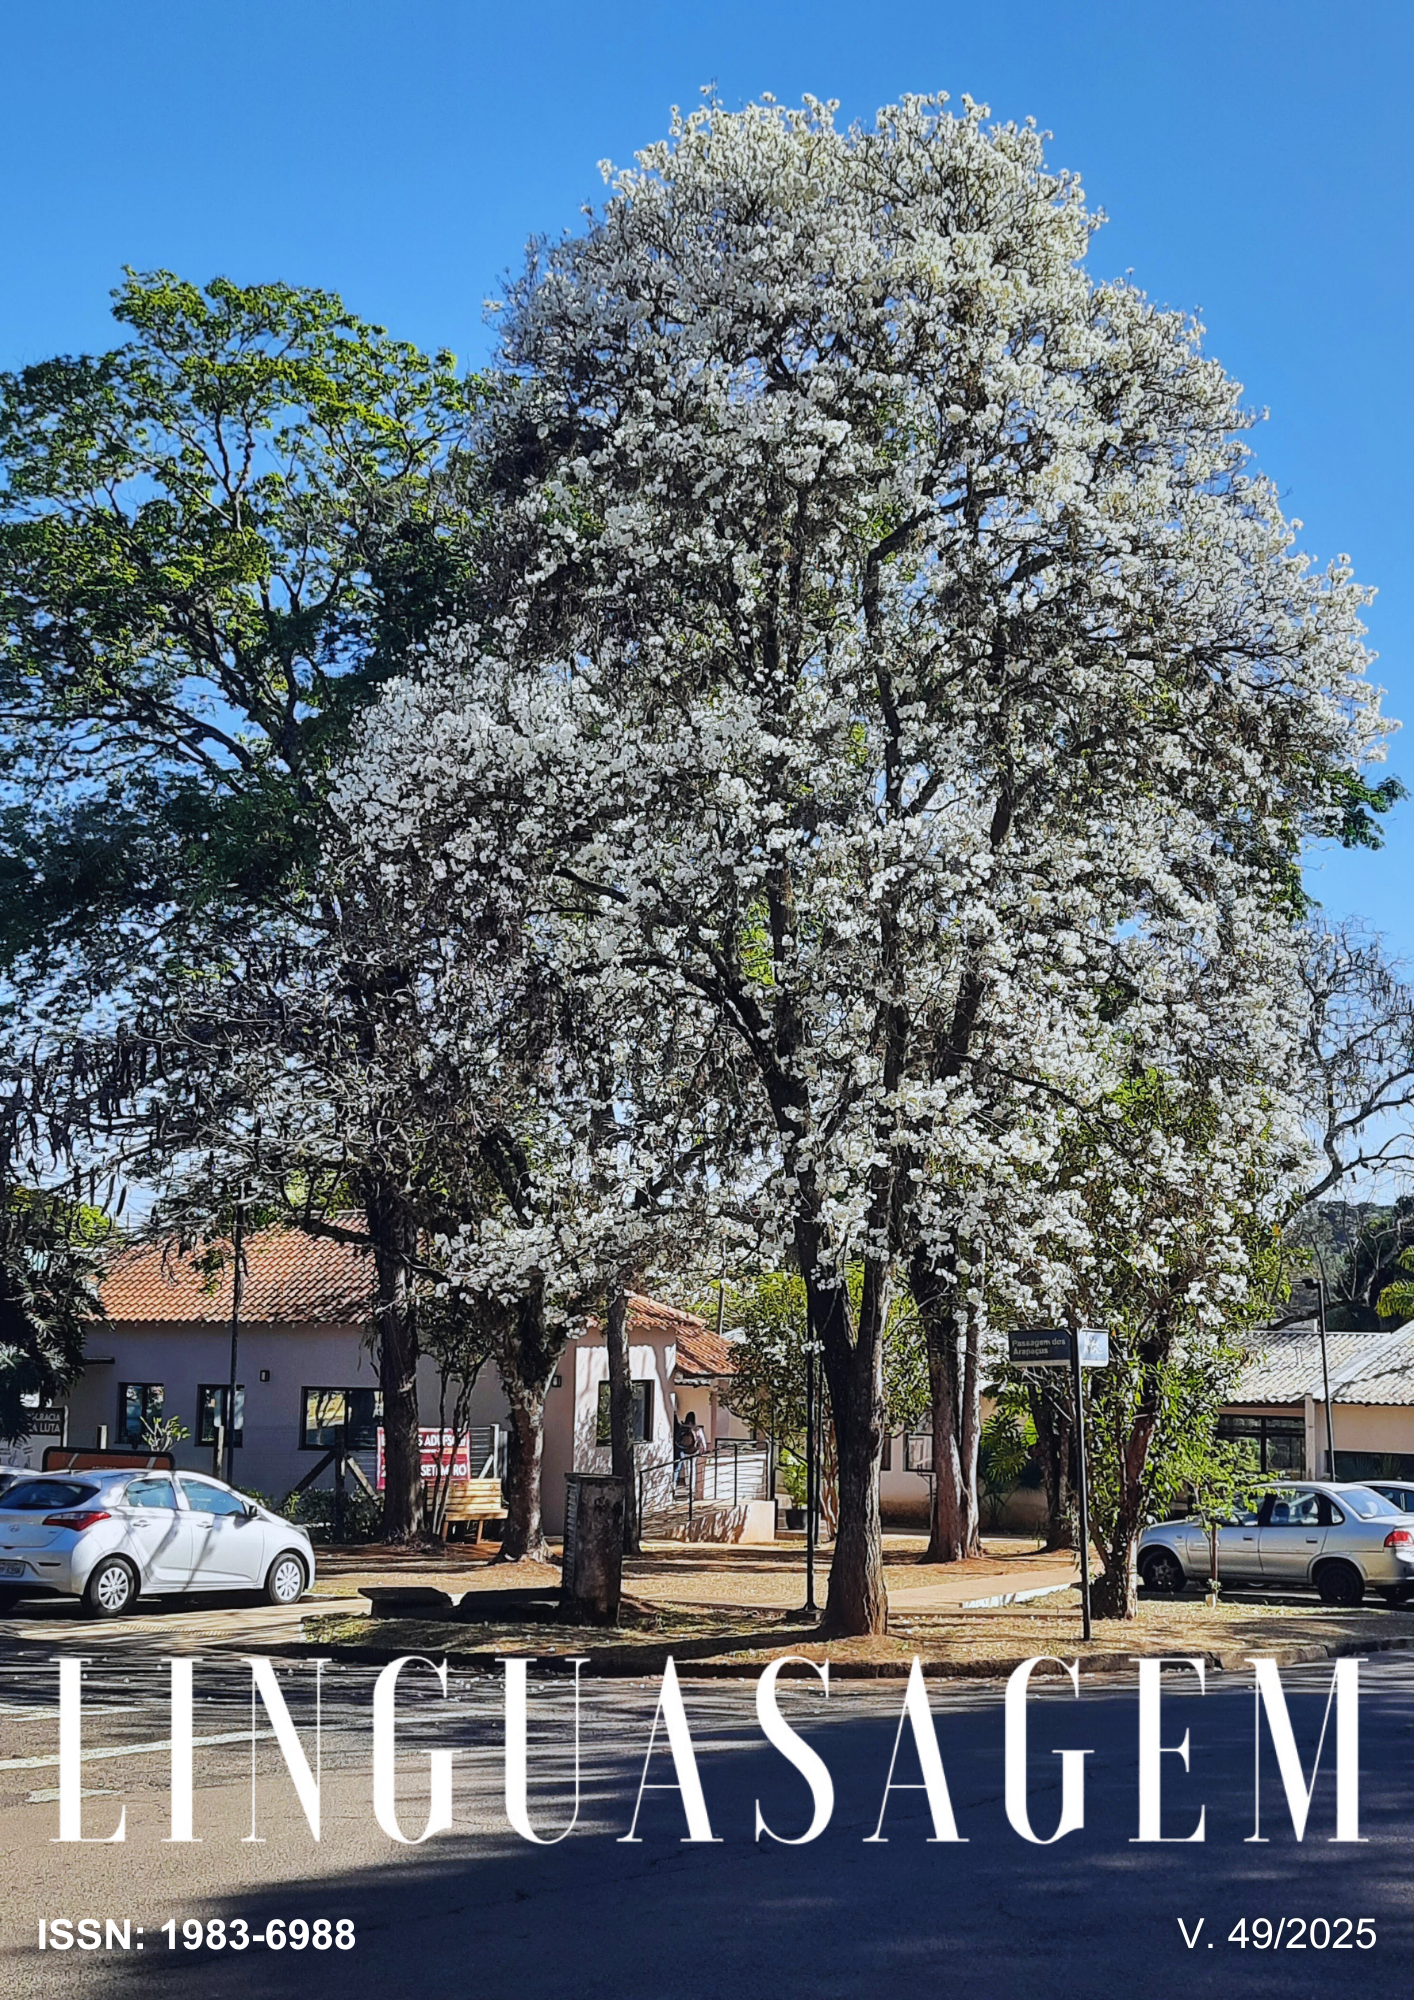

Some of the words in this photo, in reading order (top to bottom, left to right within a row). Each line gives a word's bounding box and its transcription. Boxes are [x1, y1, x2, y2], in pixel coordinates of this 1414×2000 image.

[1012, 1339, 1051, 1347] Passagem
[39, 1423, 60, 1433] LUTA
[420, 1463, 467, 1477] SETMRO
